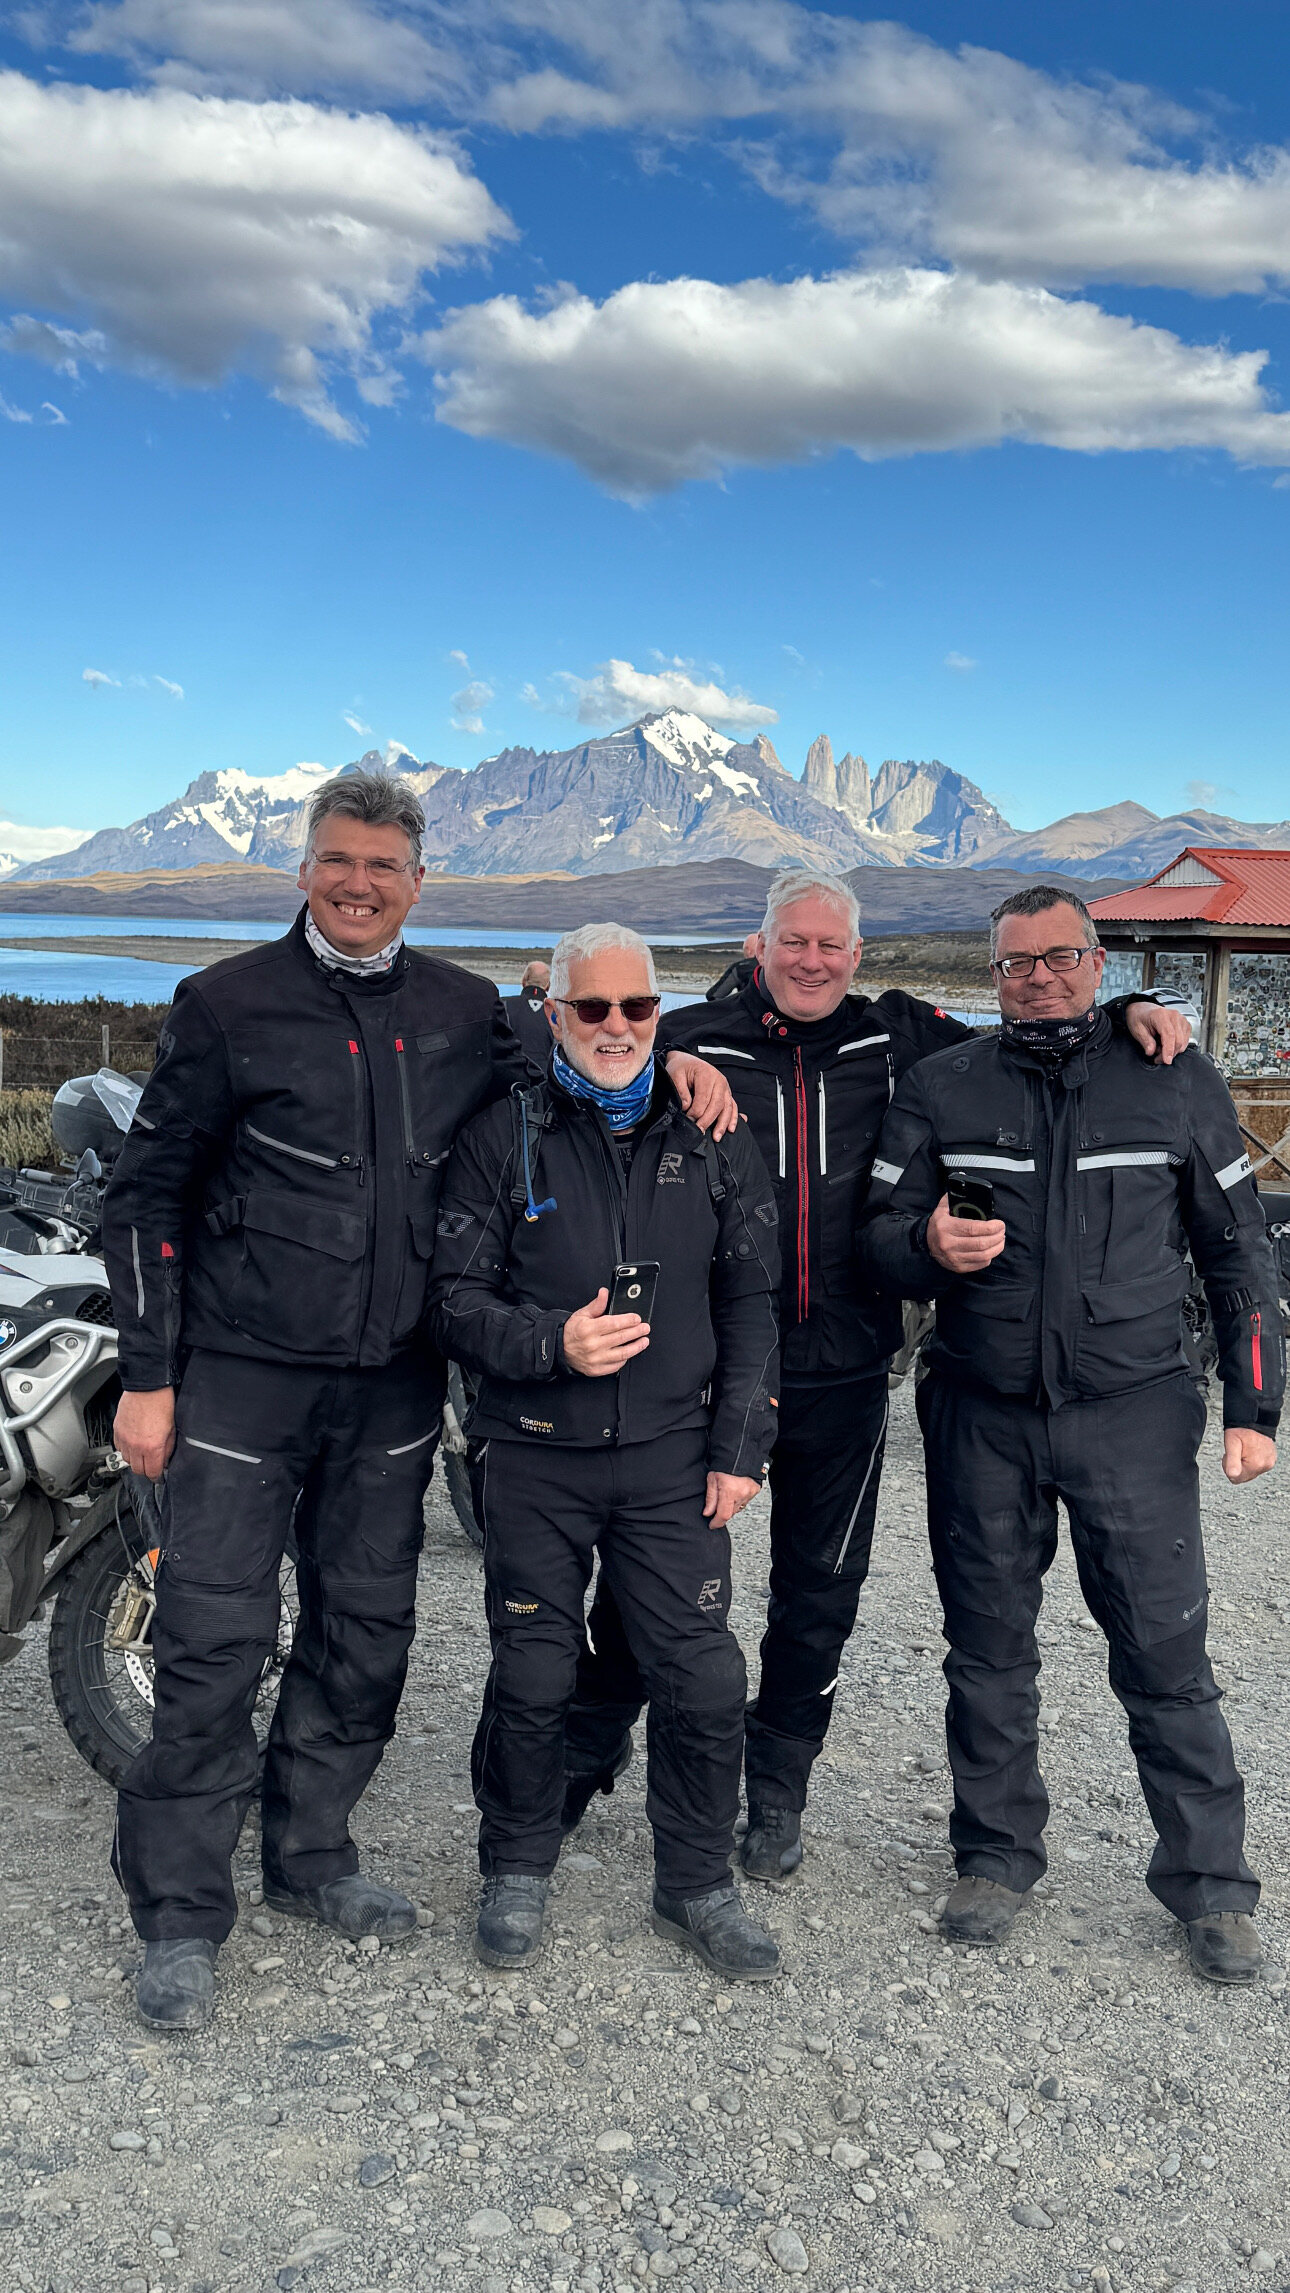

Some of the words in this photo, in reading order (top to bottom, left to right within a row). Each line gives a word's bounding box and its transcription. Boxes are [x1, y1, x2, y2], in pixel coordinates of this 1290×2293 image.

[519, 1416, 555, 1432] CORDURA
[521, 1423, 551, 1433] STRETCH
[505, 1600, 539, 1610] CORDURA
